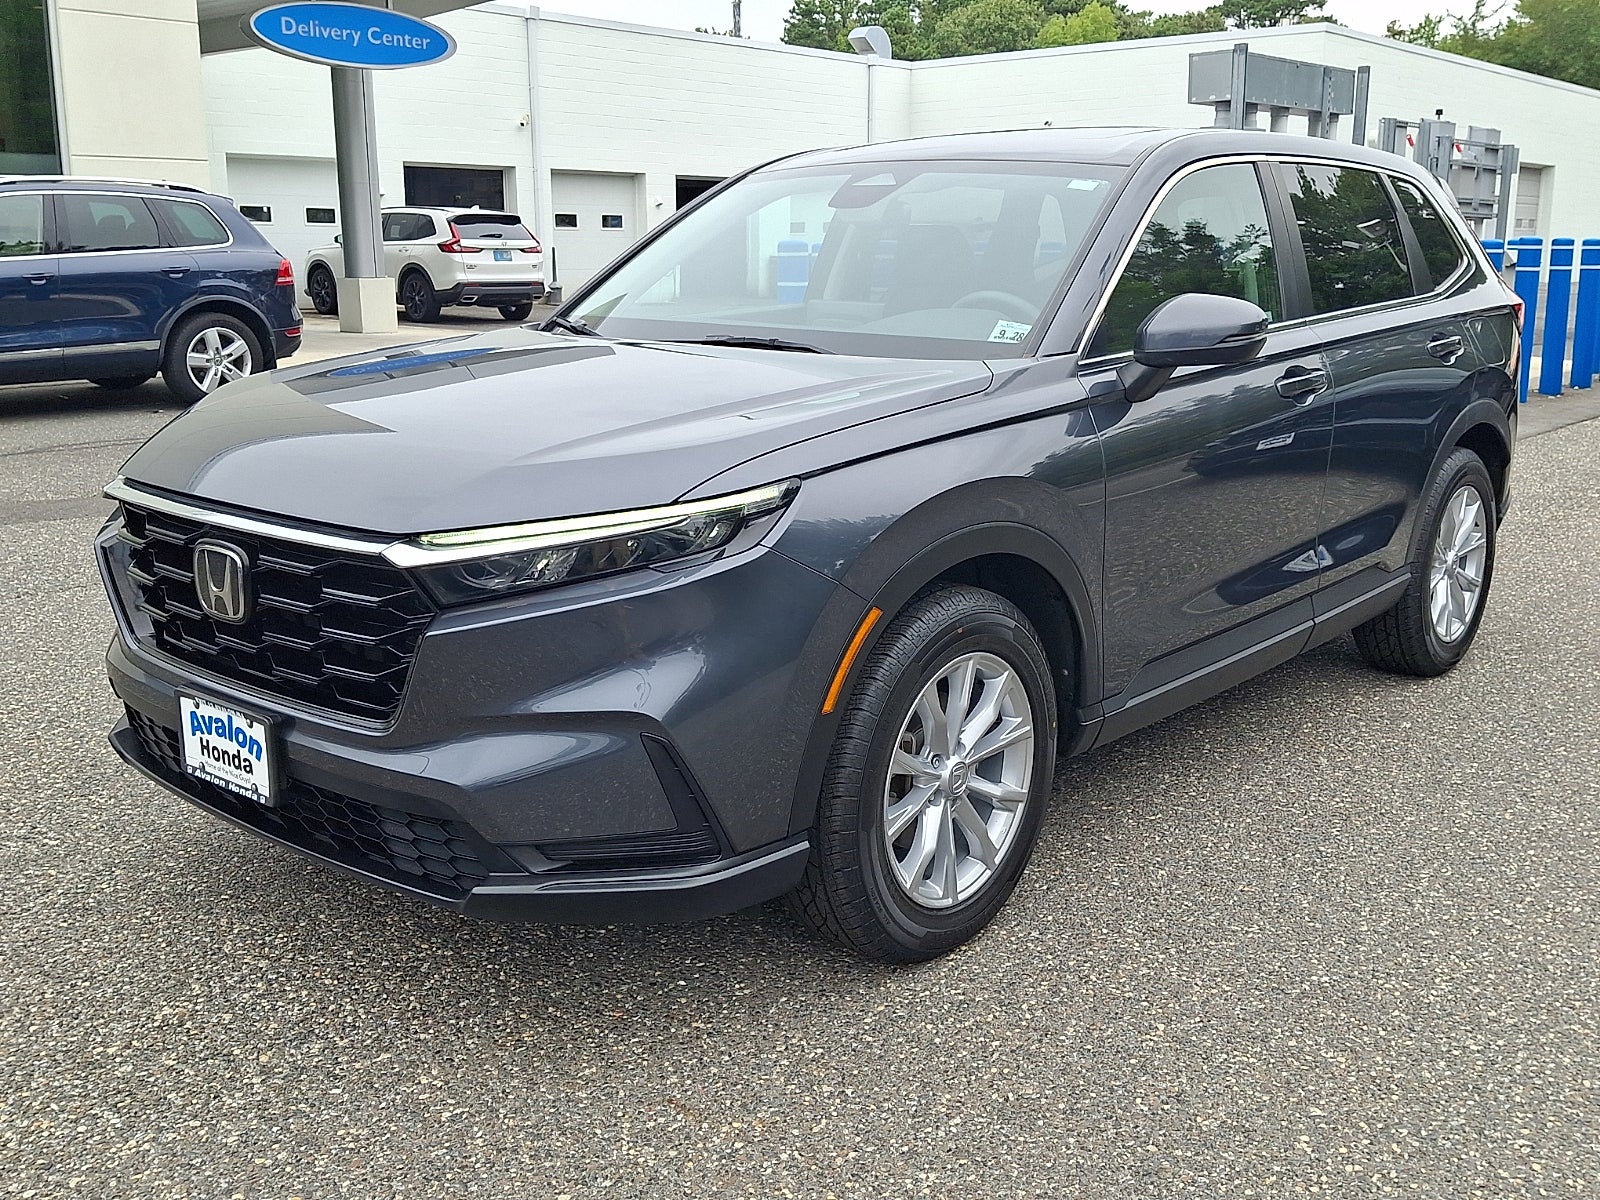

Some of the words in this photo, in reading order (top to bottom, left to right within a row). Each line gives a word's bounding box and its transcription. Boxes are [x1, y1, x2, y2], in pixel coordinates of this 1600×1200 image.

[281, 16, 361, 47] Delivery
[367, 27, 431, 50] Center
[190, 710, 263, 762] Avalon
[200, 736, 254, 776] Honda
[194, 768, 226, 788] Avalon
[228, 783, 258, 800] Honda
